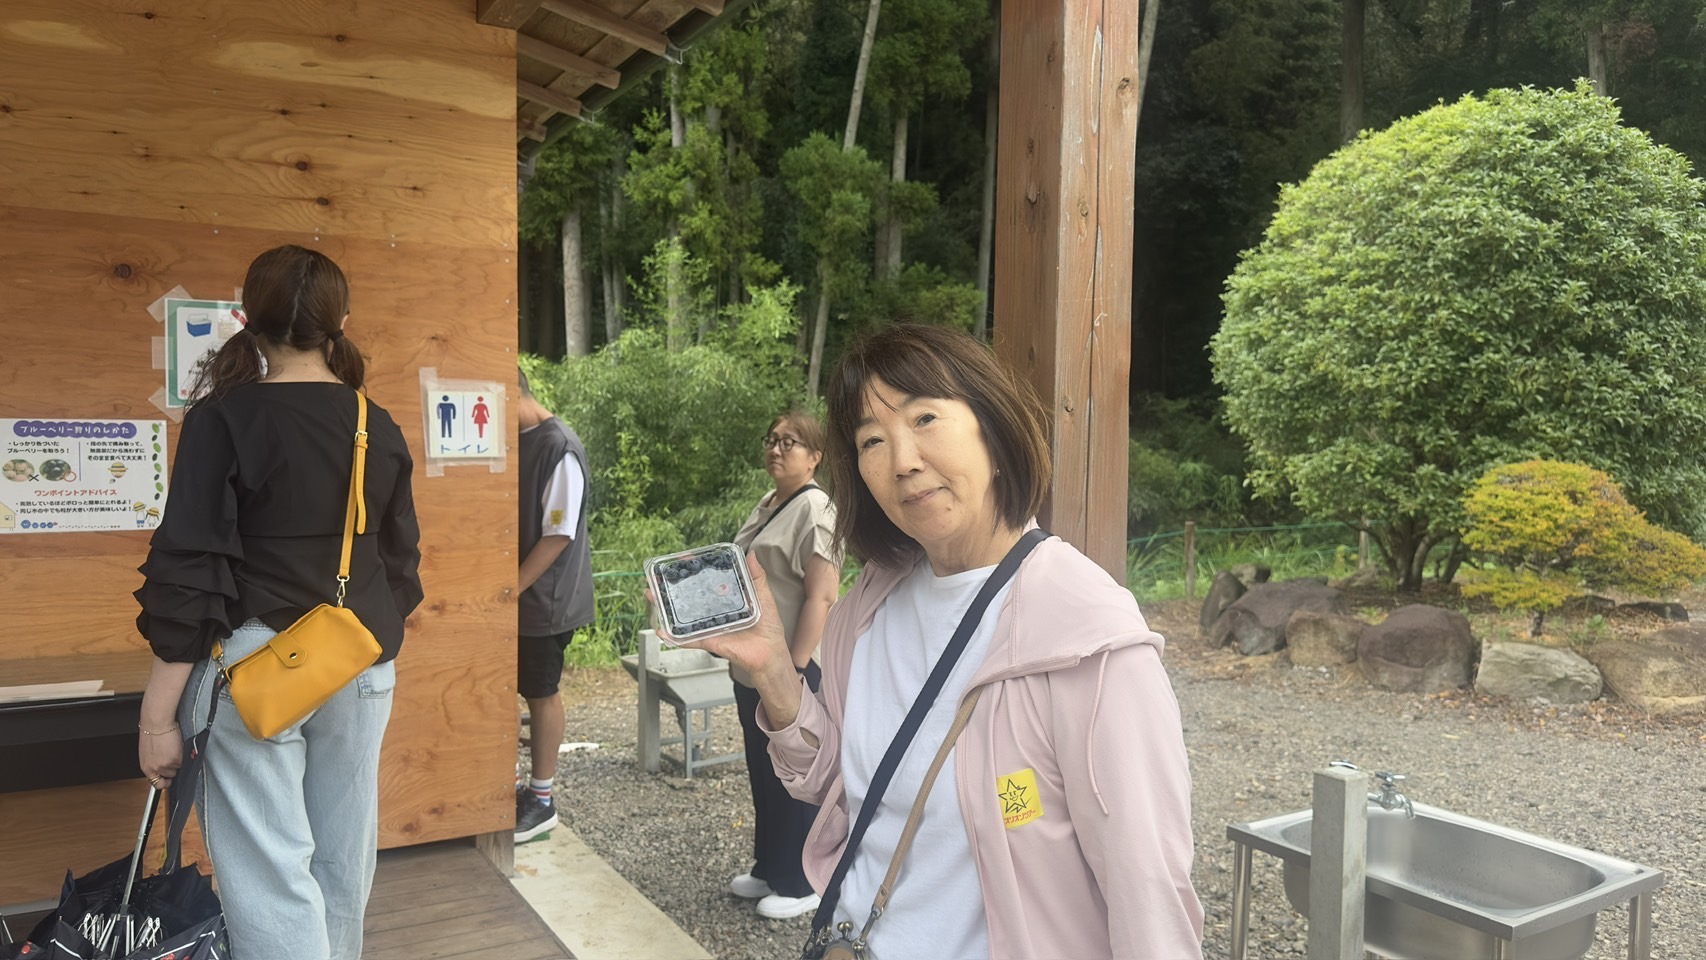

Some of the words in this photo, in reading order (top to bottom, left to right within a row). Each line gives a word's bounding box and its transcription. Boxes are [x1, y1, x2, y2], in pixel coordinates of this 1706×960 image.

[20, 425, 130, 434] ブルーベリー狩りのしかた
[441, 444, 489, 454] トイレ
[34, 489, 118, 497] ワンポイントアドバイス
